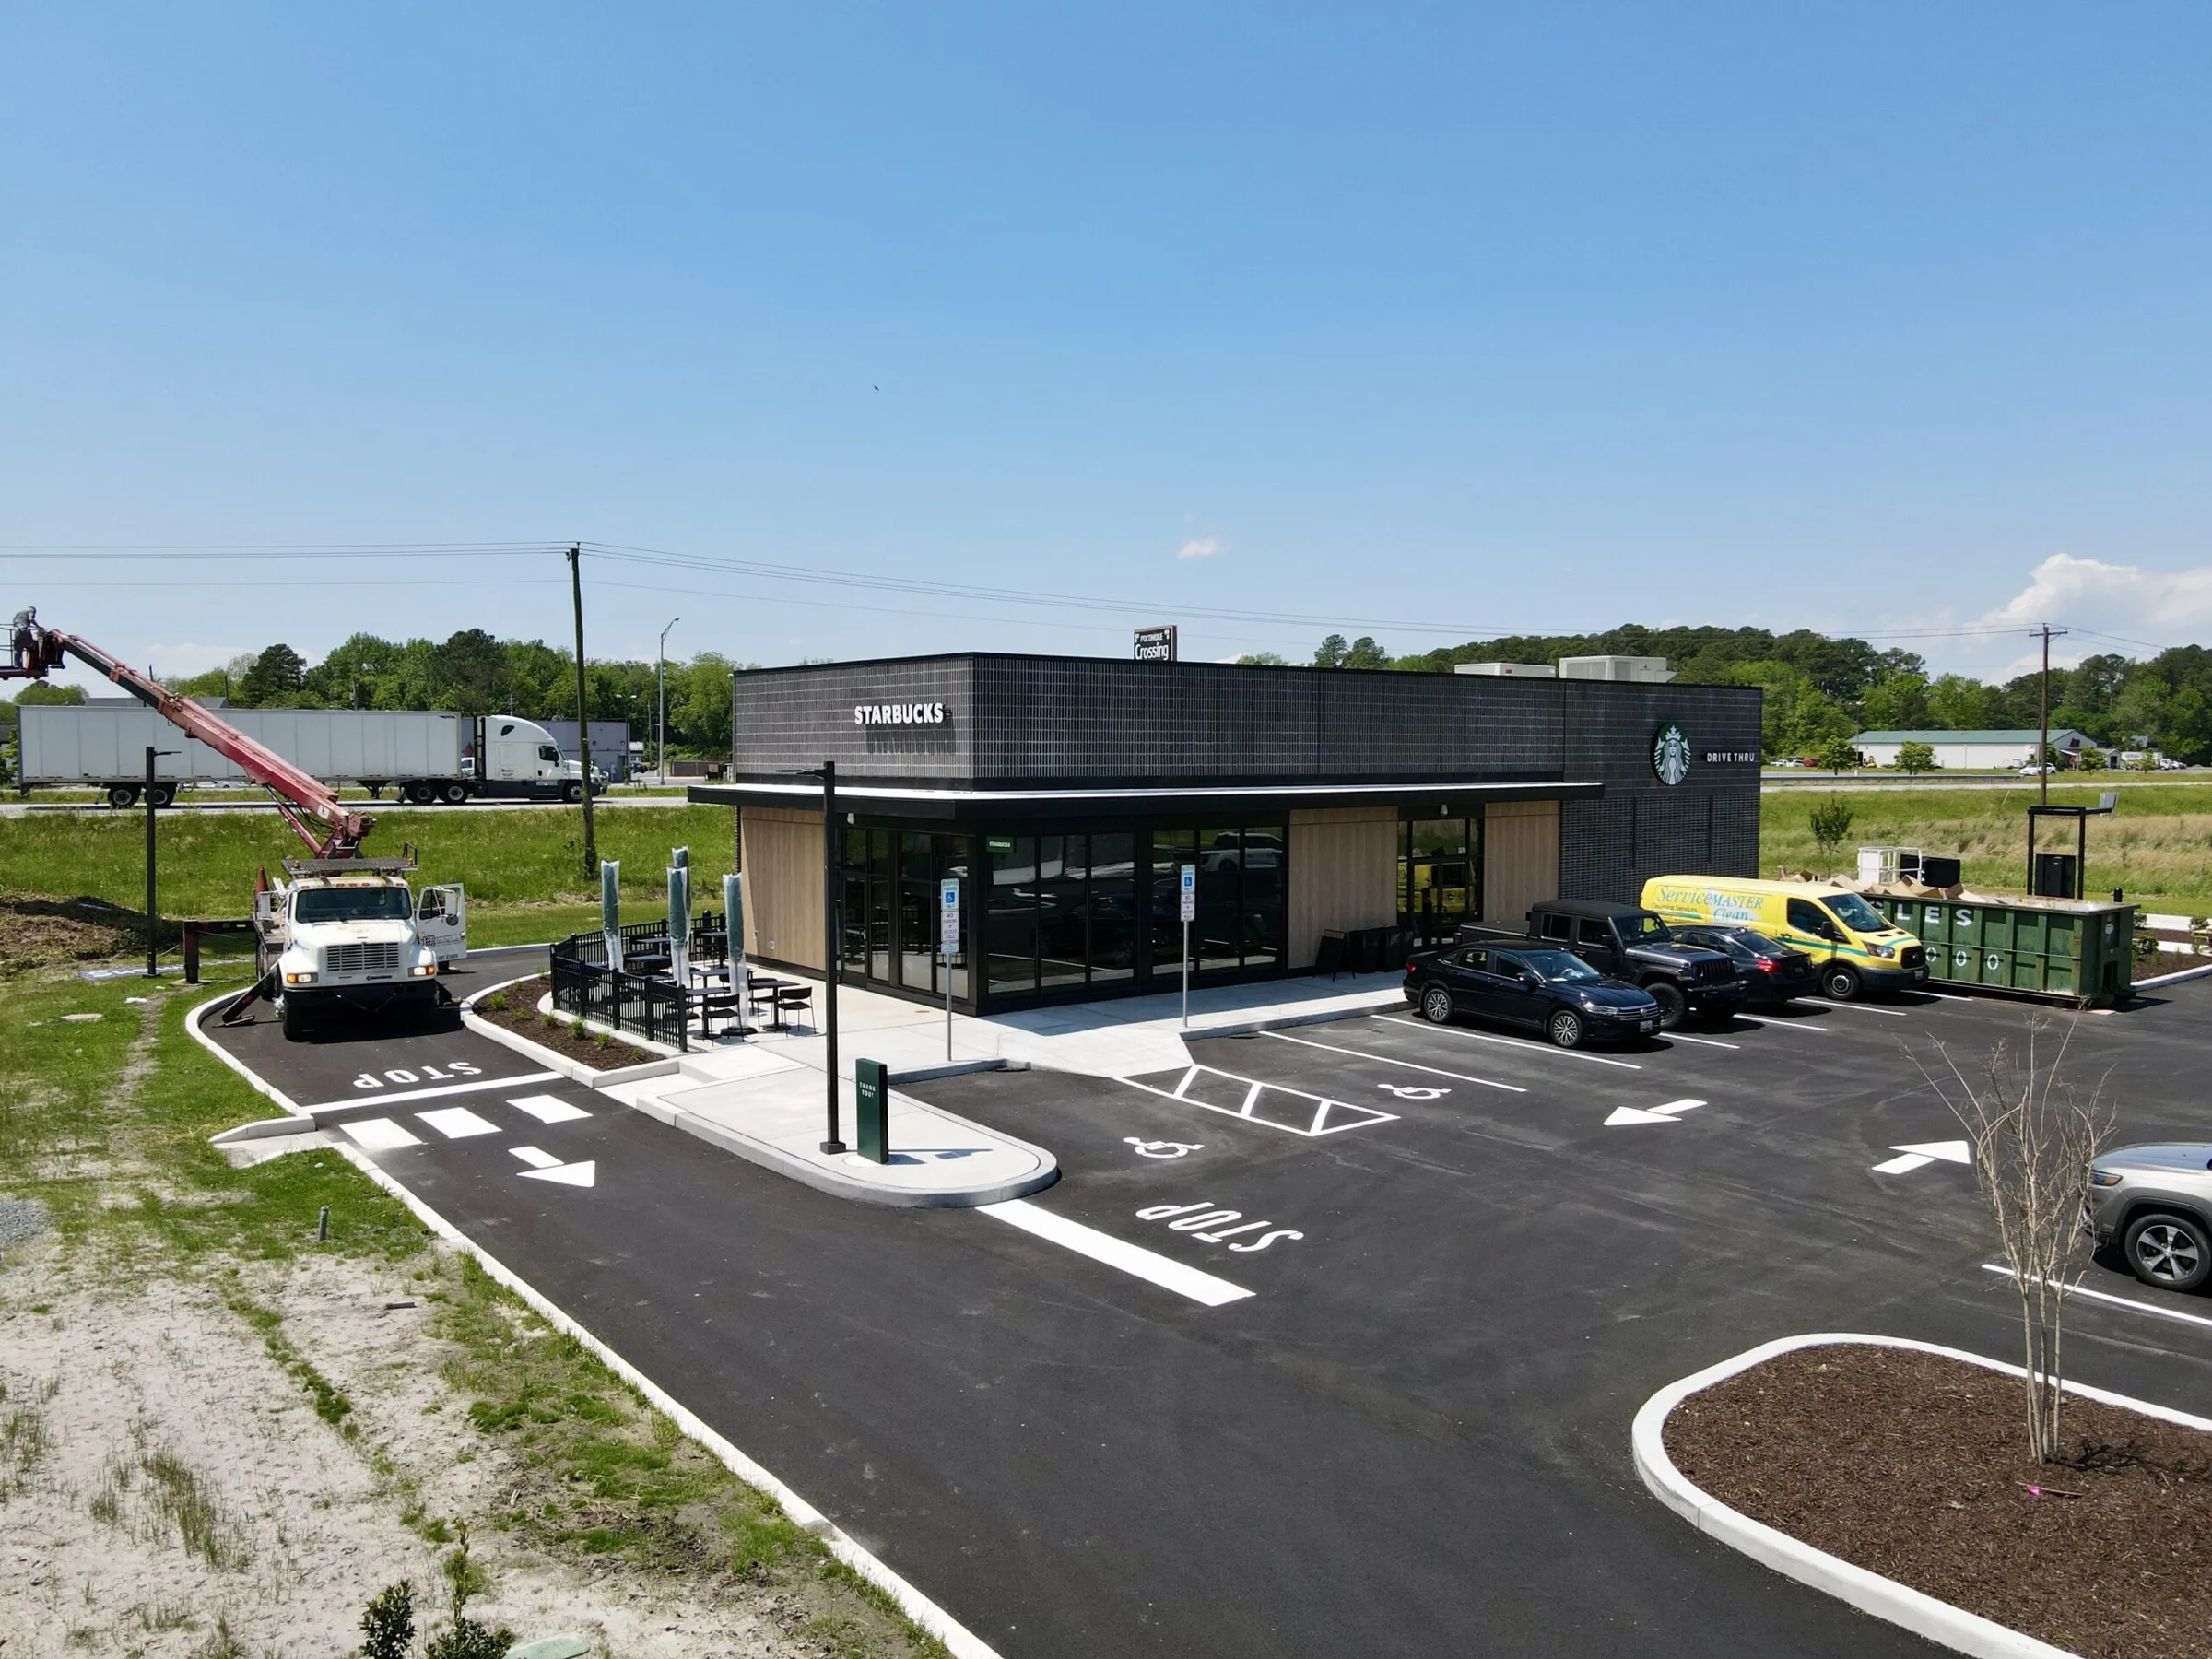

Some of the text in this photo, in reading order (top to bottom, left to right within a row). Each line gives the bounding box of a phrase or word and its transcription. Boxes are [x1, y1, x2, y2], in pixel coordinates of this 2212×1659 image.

[1135, 641, 1169, 661] Crossing
[854, 702, 944, 724] STARBUCKS
[1707, 752, 1755, 762] DRIVE THRU
[353, 1061, 482, 1088] STOP
[859, 1081, 876, 1092] THANK
[1135, 1202, 1304, 1253] STOP
